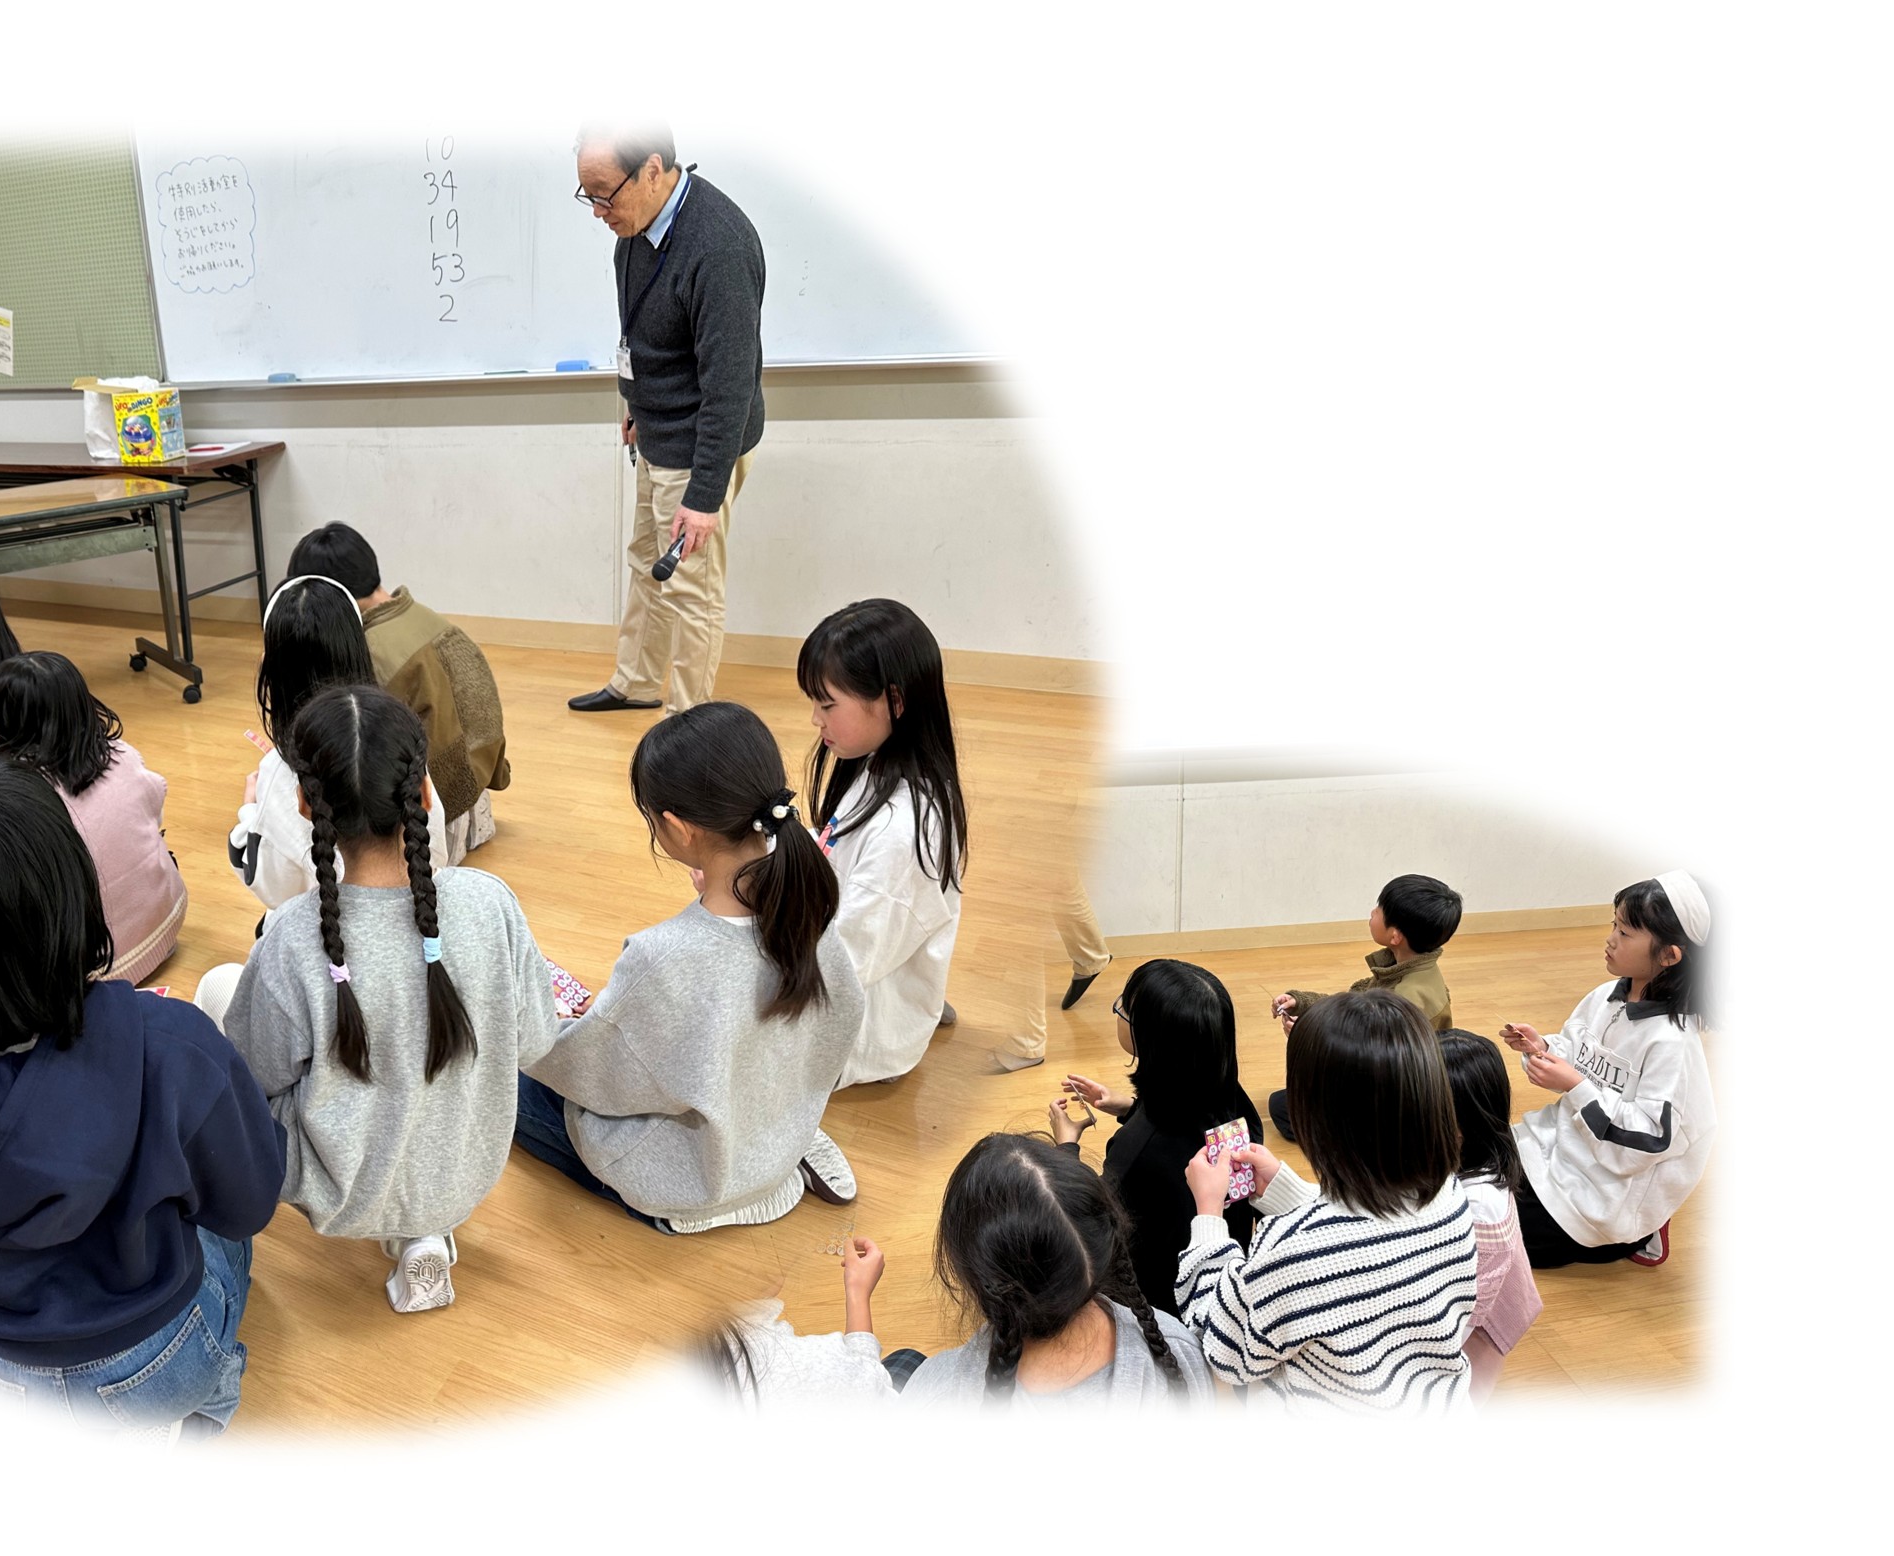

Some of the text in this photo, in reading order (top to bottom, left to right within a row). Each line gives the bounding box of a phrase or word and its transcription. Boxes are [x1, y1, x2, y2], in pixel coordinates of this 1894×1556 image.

[425, 135, 455, 163] 10
[423, 169, 458, 206] 34
[429, 208, 459, 248] 19
[431, 252, 466, 286] 53
[438, 294, 459, 322] 2
